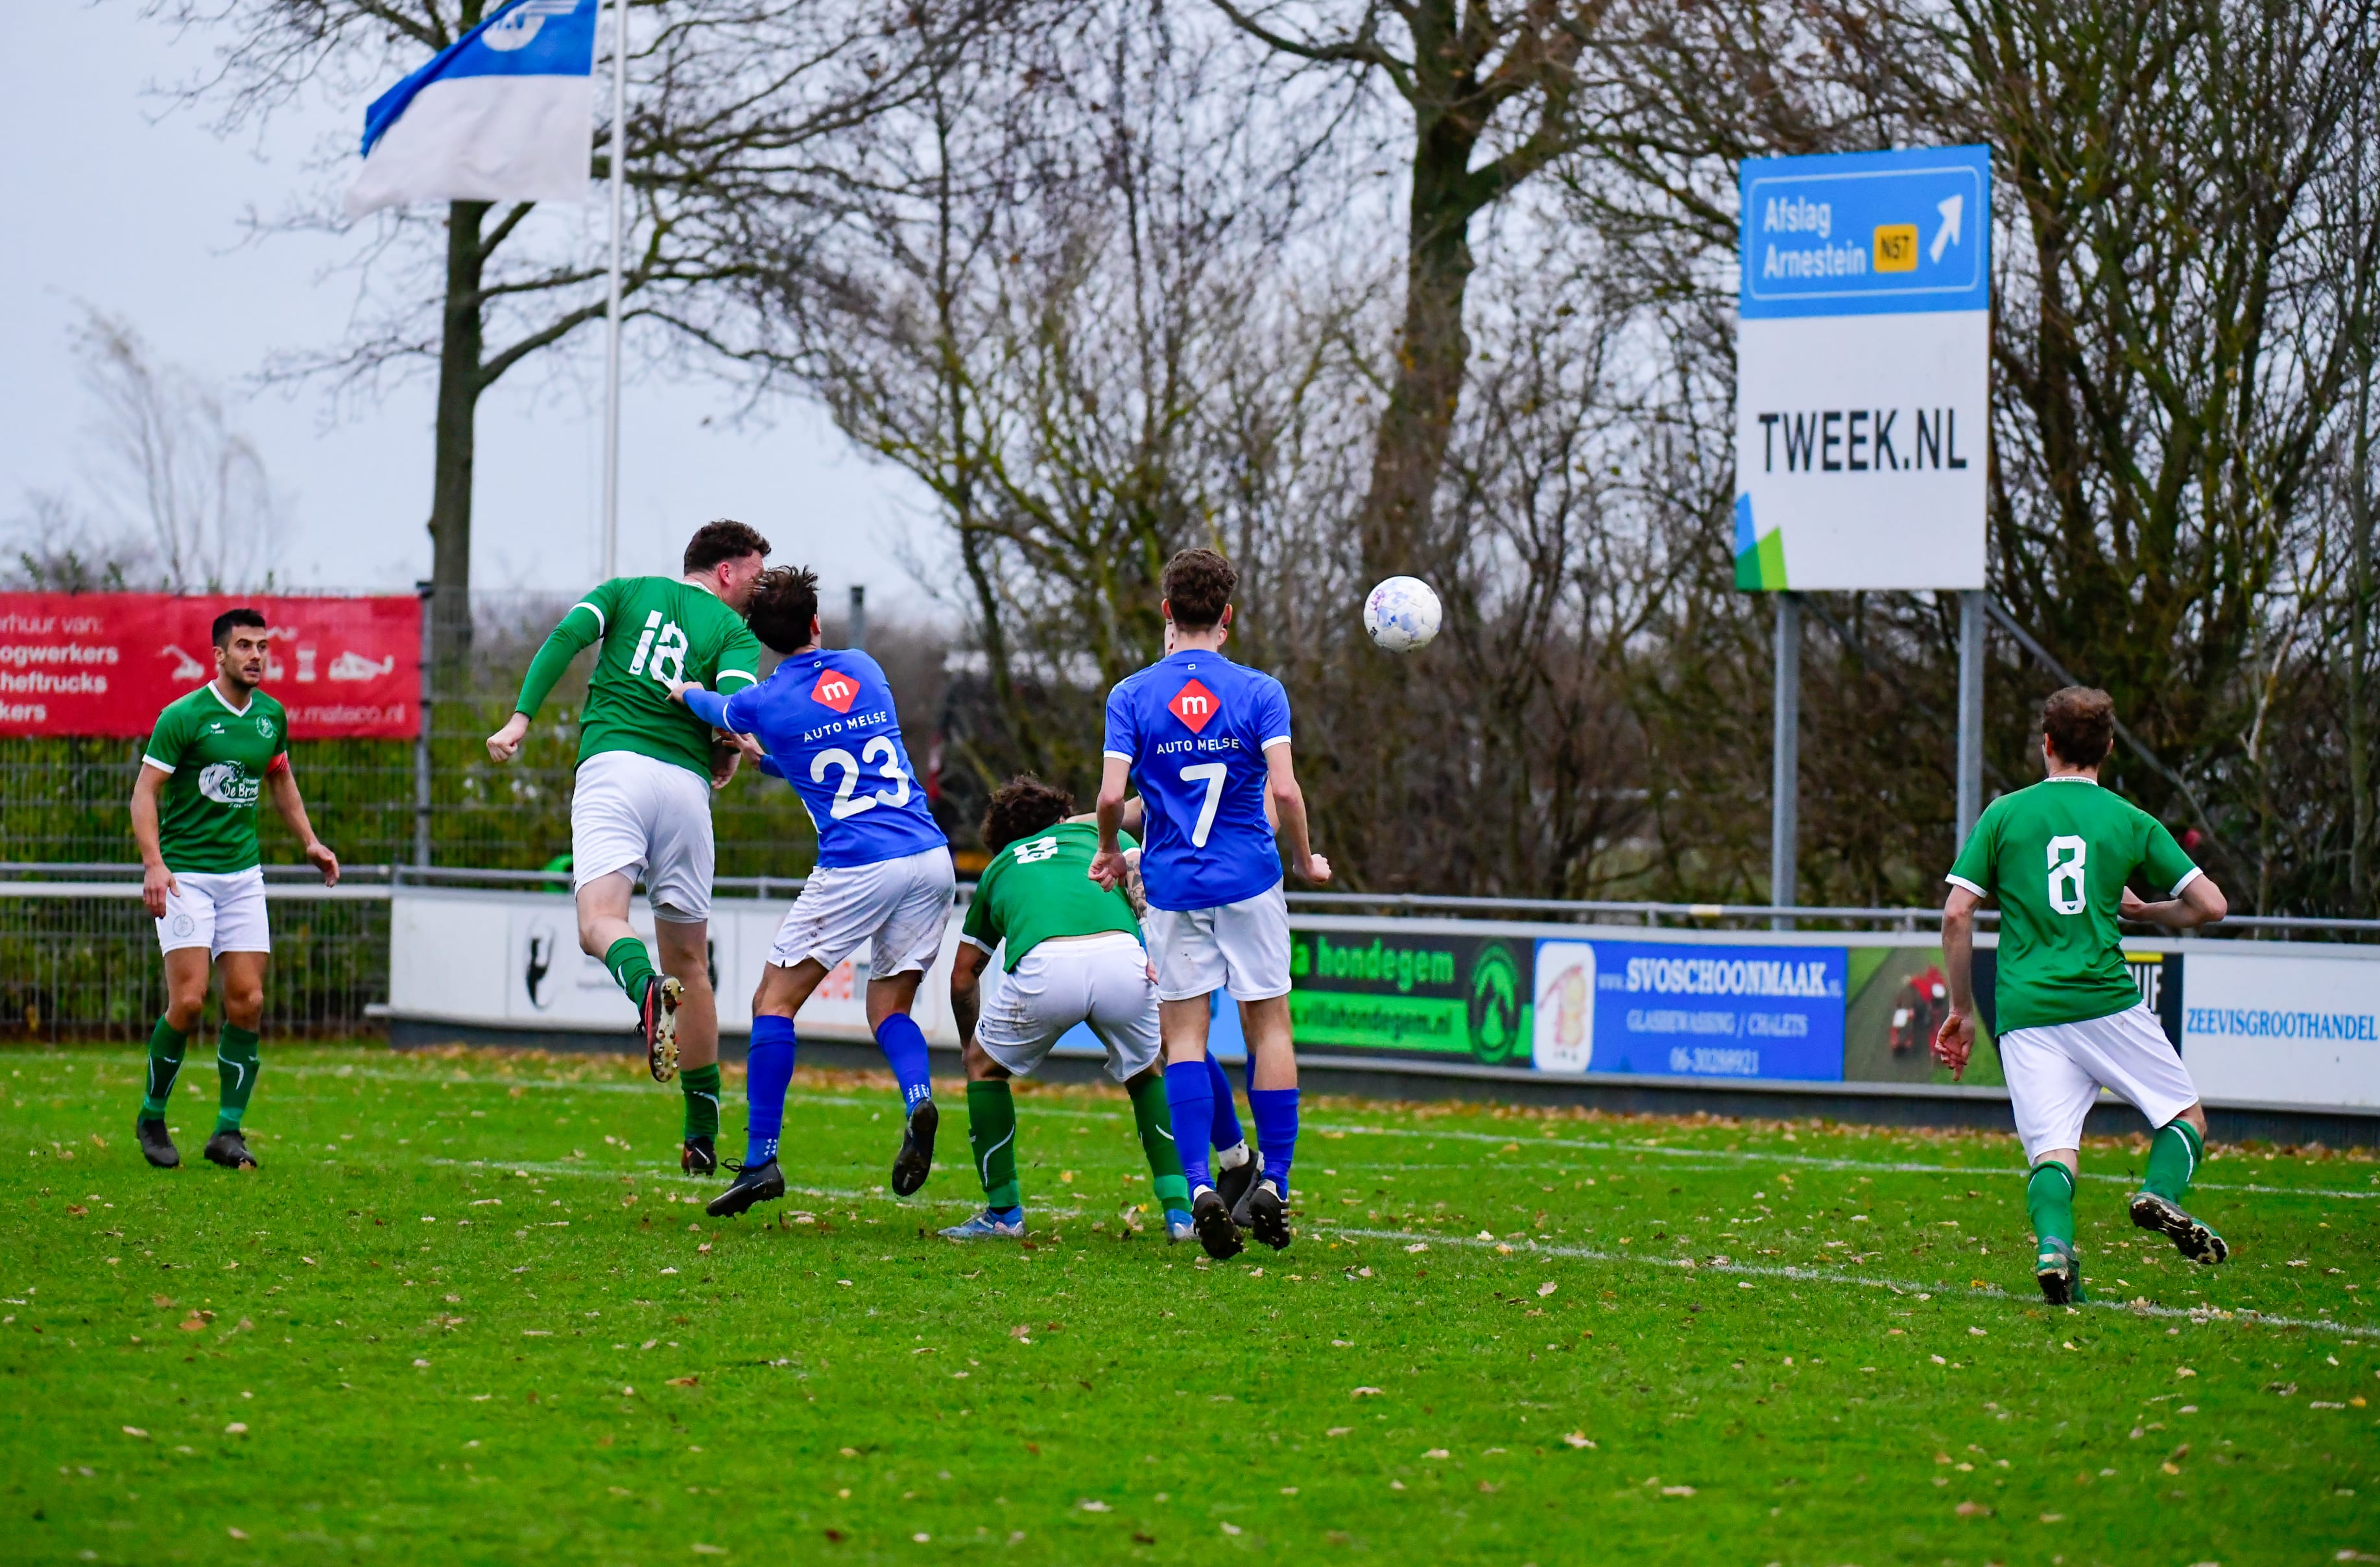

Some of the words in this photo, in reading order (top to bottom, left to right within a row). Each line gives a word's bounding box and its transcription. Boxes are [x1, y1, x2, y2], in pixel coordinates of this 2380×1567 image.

[1763, 196, 1831, 239] Afslag
[1763, 239, 1867, 279] Arnestein
[1881, 235, 1910, 260] N57
[1757, 408, 1967, 472] TWEEK.NL
[0, 641, 119, 668] ogwerkers
[628, 610, 689, 691] 18
[1, 670, 108, 693] heftrucks
[822, 681, 850, 701] m
[1182, 696, 1208, 715] m
[803, 722, 842, 743] AUTO
[846, 711, 887, 730] MELSE
[1156, 740, 1193, 754] AUTO
[1197, 737, 1239, 751] MELSE
[810, 736, 909, 820] 23
[1180, 763, 1228, 848] 7
[2047, 835, 2087, 915] 8
[1317, 935, 1455, 992] hondegem
[2187, 1008, 2379, 1041] ZEEVISGROOTHANDEL
